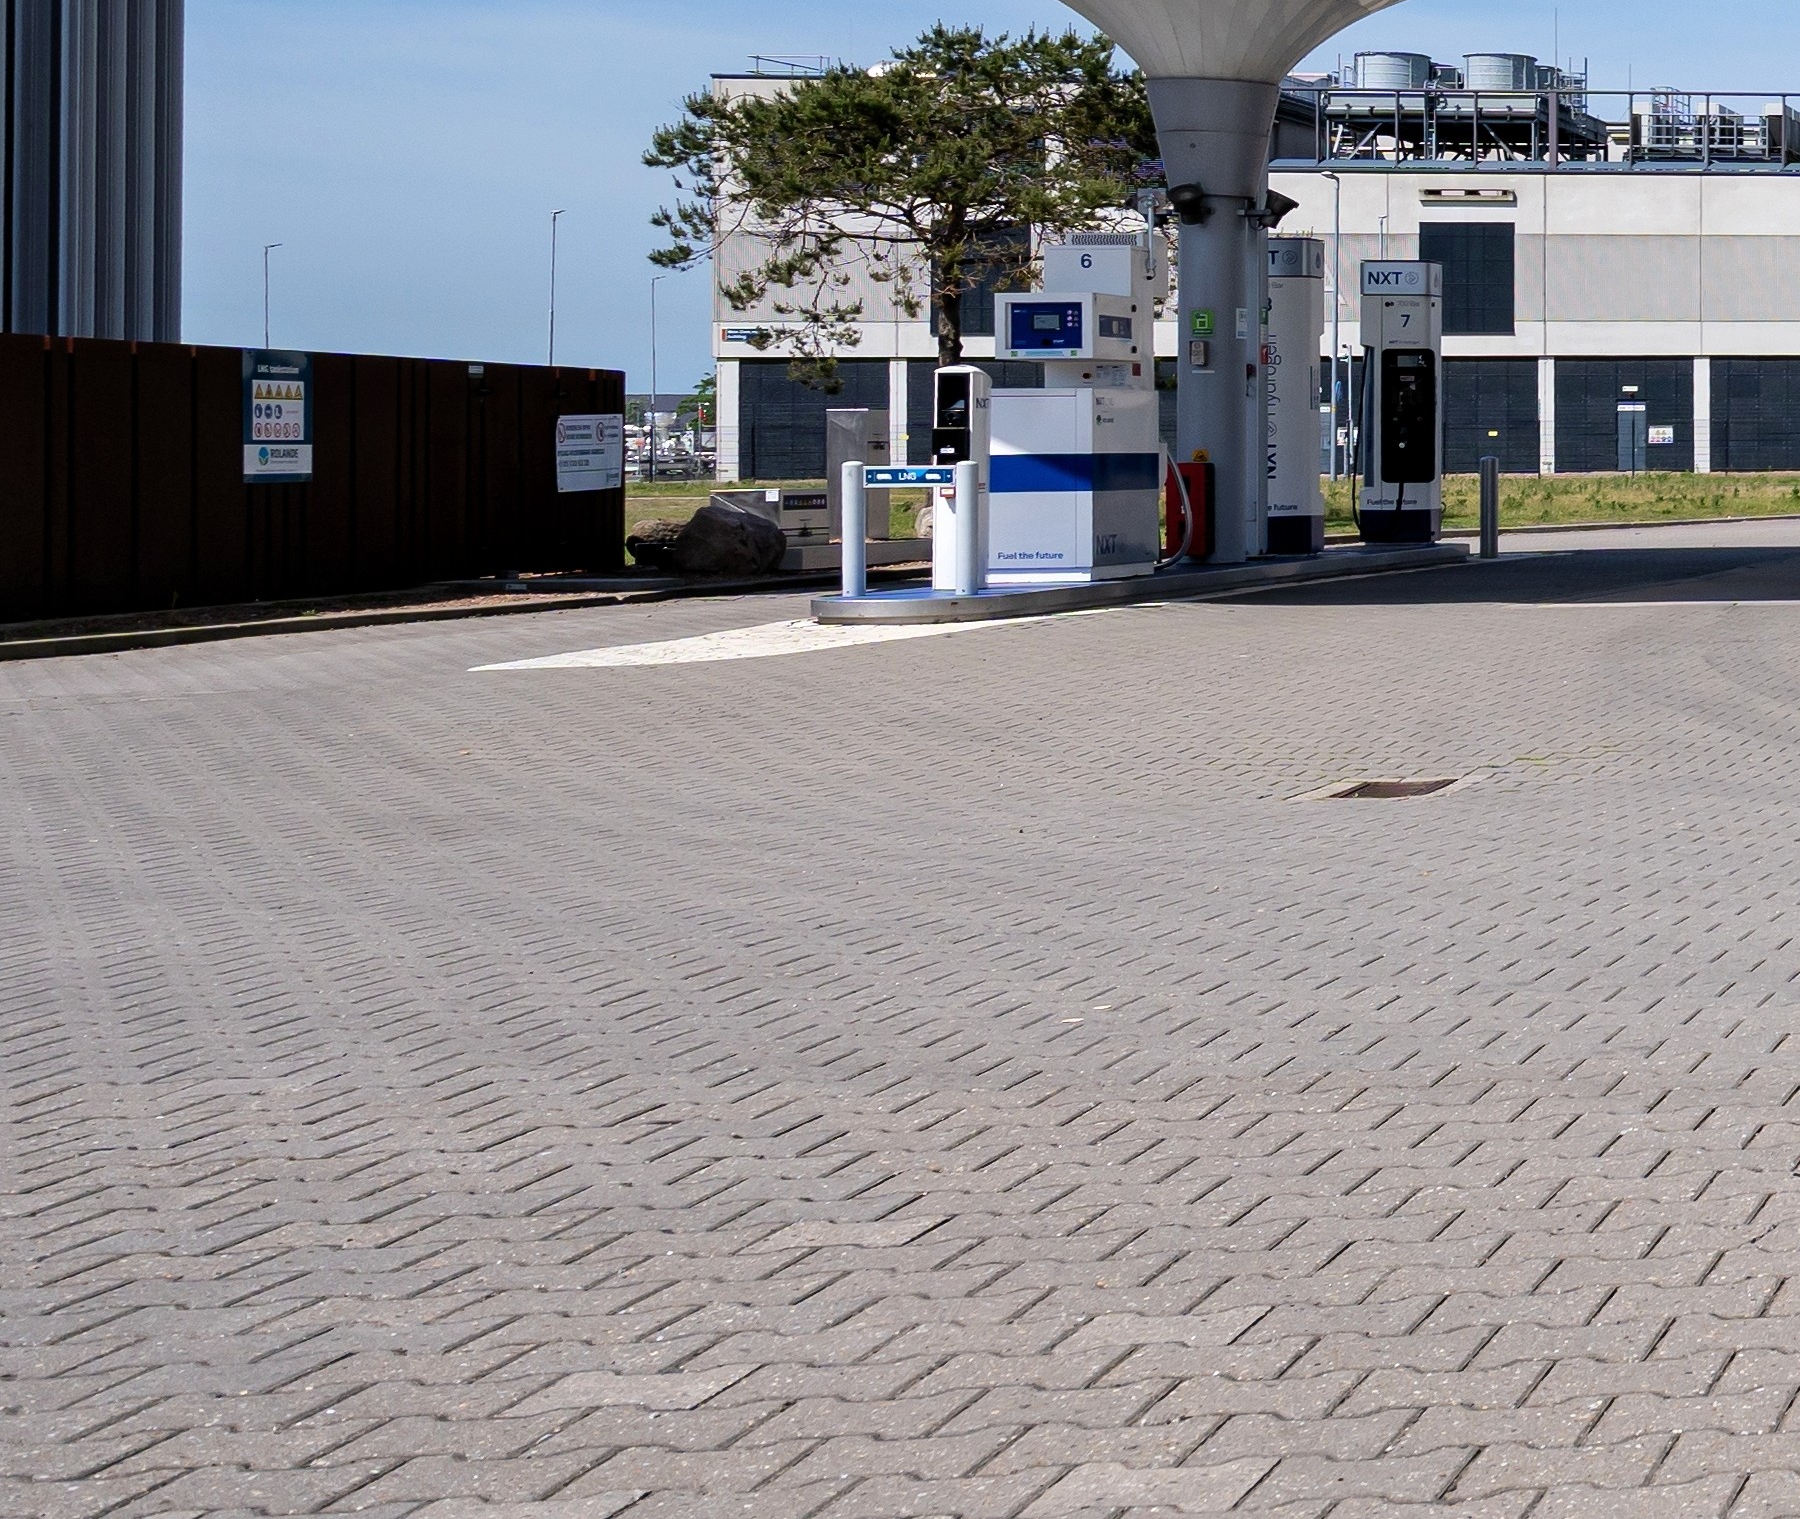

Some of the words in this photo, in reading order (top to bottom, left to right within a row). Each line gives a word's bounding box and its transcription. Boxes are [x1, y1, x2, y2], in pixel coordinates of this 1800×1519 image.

[1080, 253, 1092, 268] 6
[1367, 271, 1403, 285] NXT
[1400, 314, 1411, 327] 7
[898, 472, 917, 480] LNG
[1096, 534, 1118, 555] NXT
[1035, 551, 1064, 559] future
